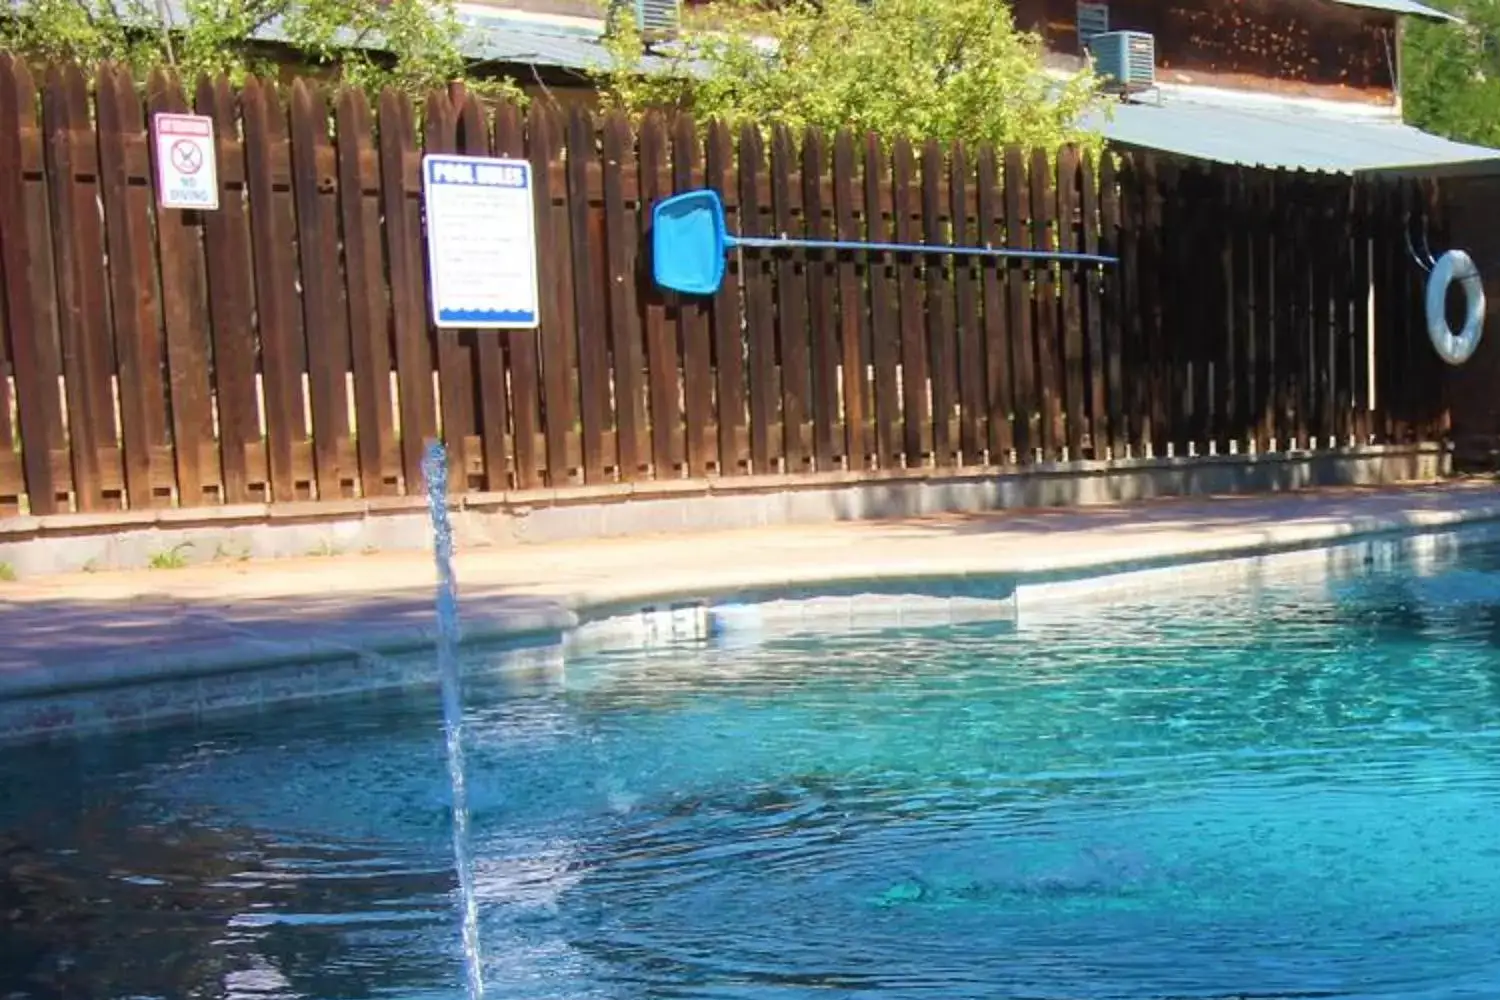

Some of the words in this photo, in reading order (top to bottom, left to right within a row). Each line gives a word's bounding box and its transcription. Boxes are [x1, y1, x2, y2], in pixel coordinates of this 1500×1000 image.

[433, 162, 473, 183] POOL
[180, 176, 197, 188] NO
[170, 189, 209, 202] DIVING
